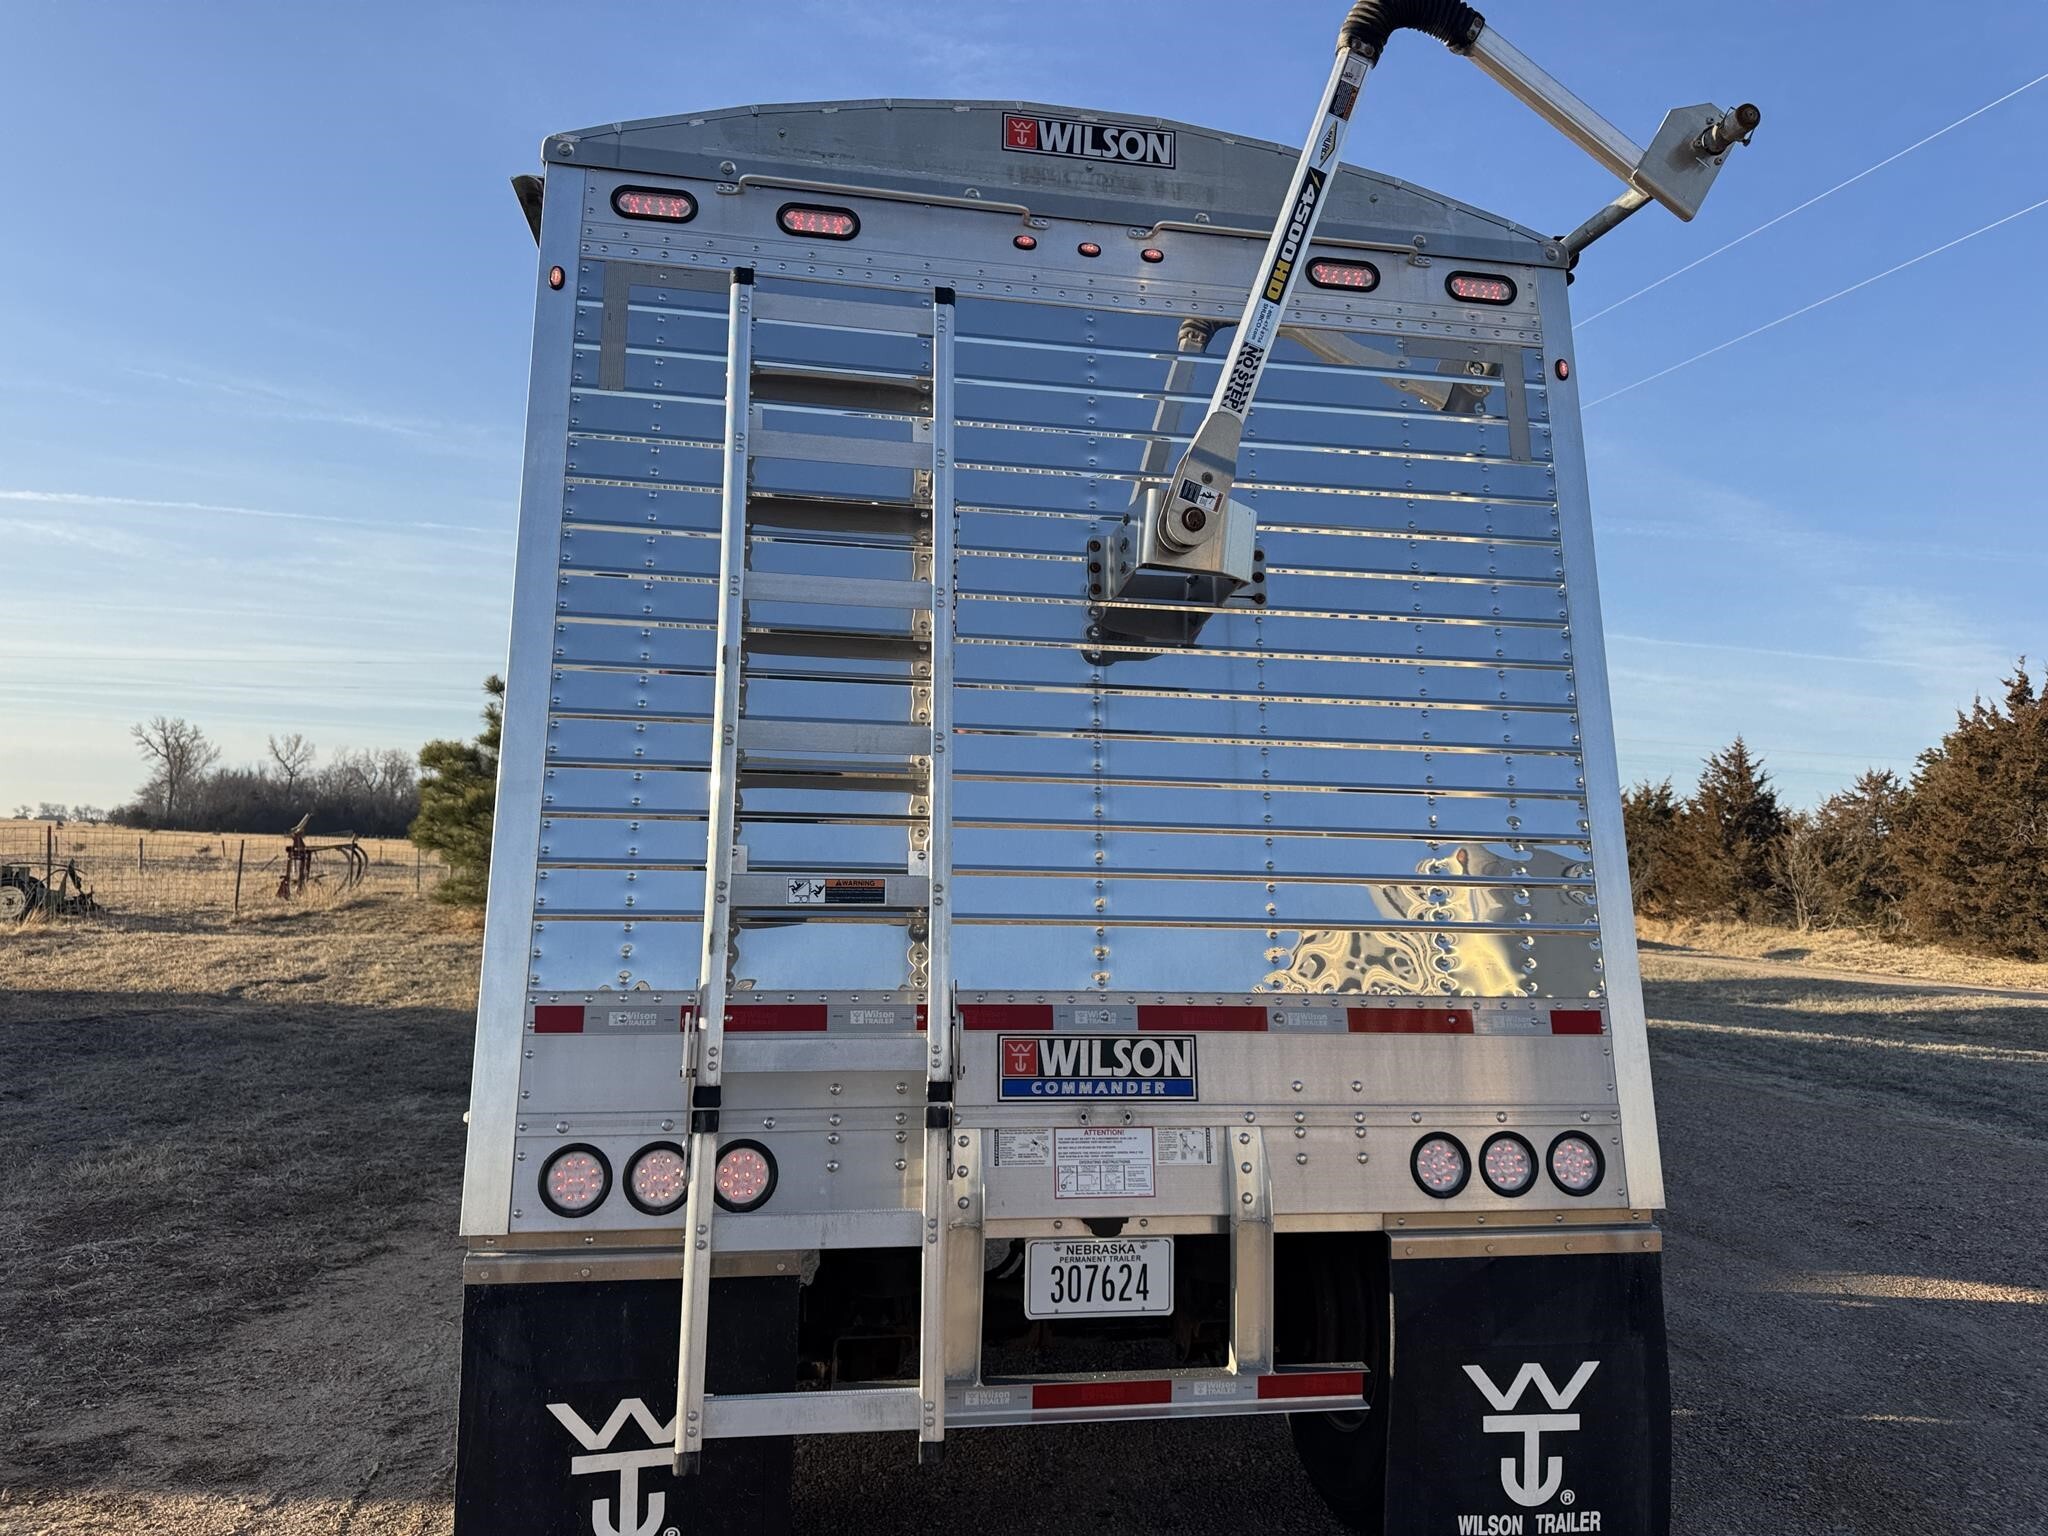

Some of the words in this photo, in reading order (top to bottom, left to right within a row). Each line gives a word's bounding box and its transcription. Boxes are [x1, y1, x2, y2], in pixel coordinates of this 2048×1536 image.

[1038, 120, 1171, 164] WILSON
[1266, 183, 1316, 300] 4500HD
[1243, 345, 1261, 369] NO
[1228, 370, 1249, 410] STEP
[1039, 1039, 1191, 1077] WILSON
[1031, 1081, 1166, 1095] COMMANDER
[1060, 1255, 1107, 1263] PERMANENT
[1066, 1243, 1136, 1255] NEBRASKA
[1051, 1263, 1150, 1303] 307624
[1457, 1514, 1524, 1536] WILSON
[1535, 1511, 1601, 1534] TRAILER
